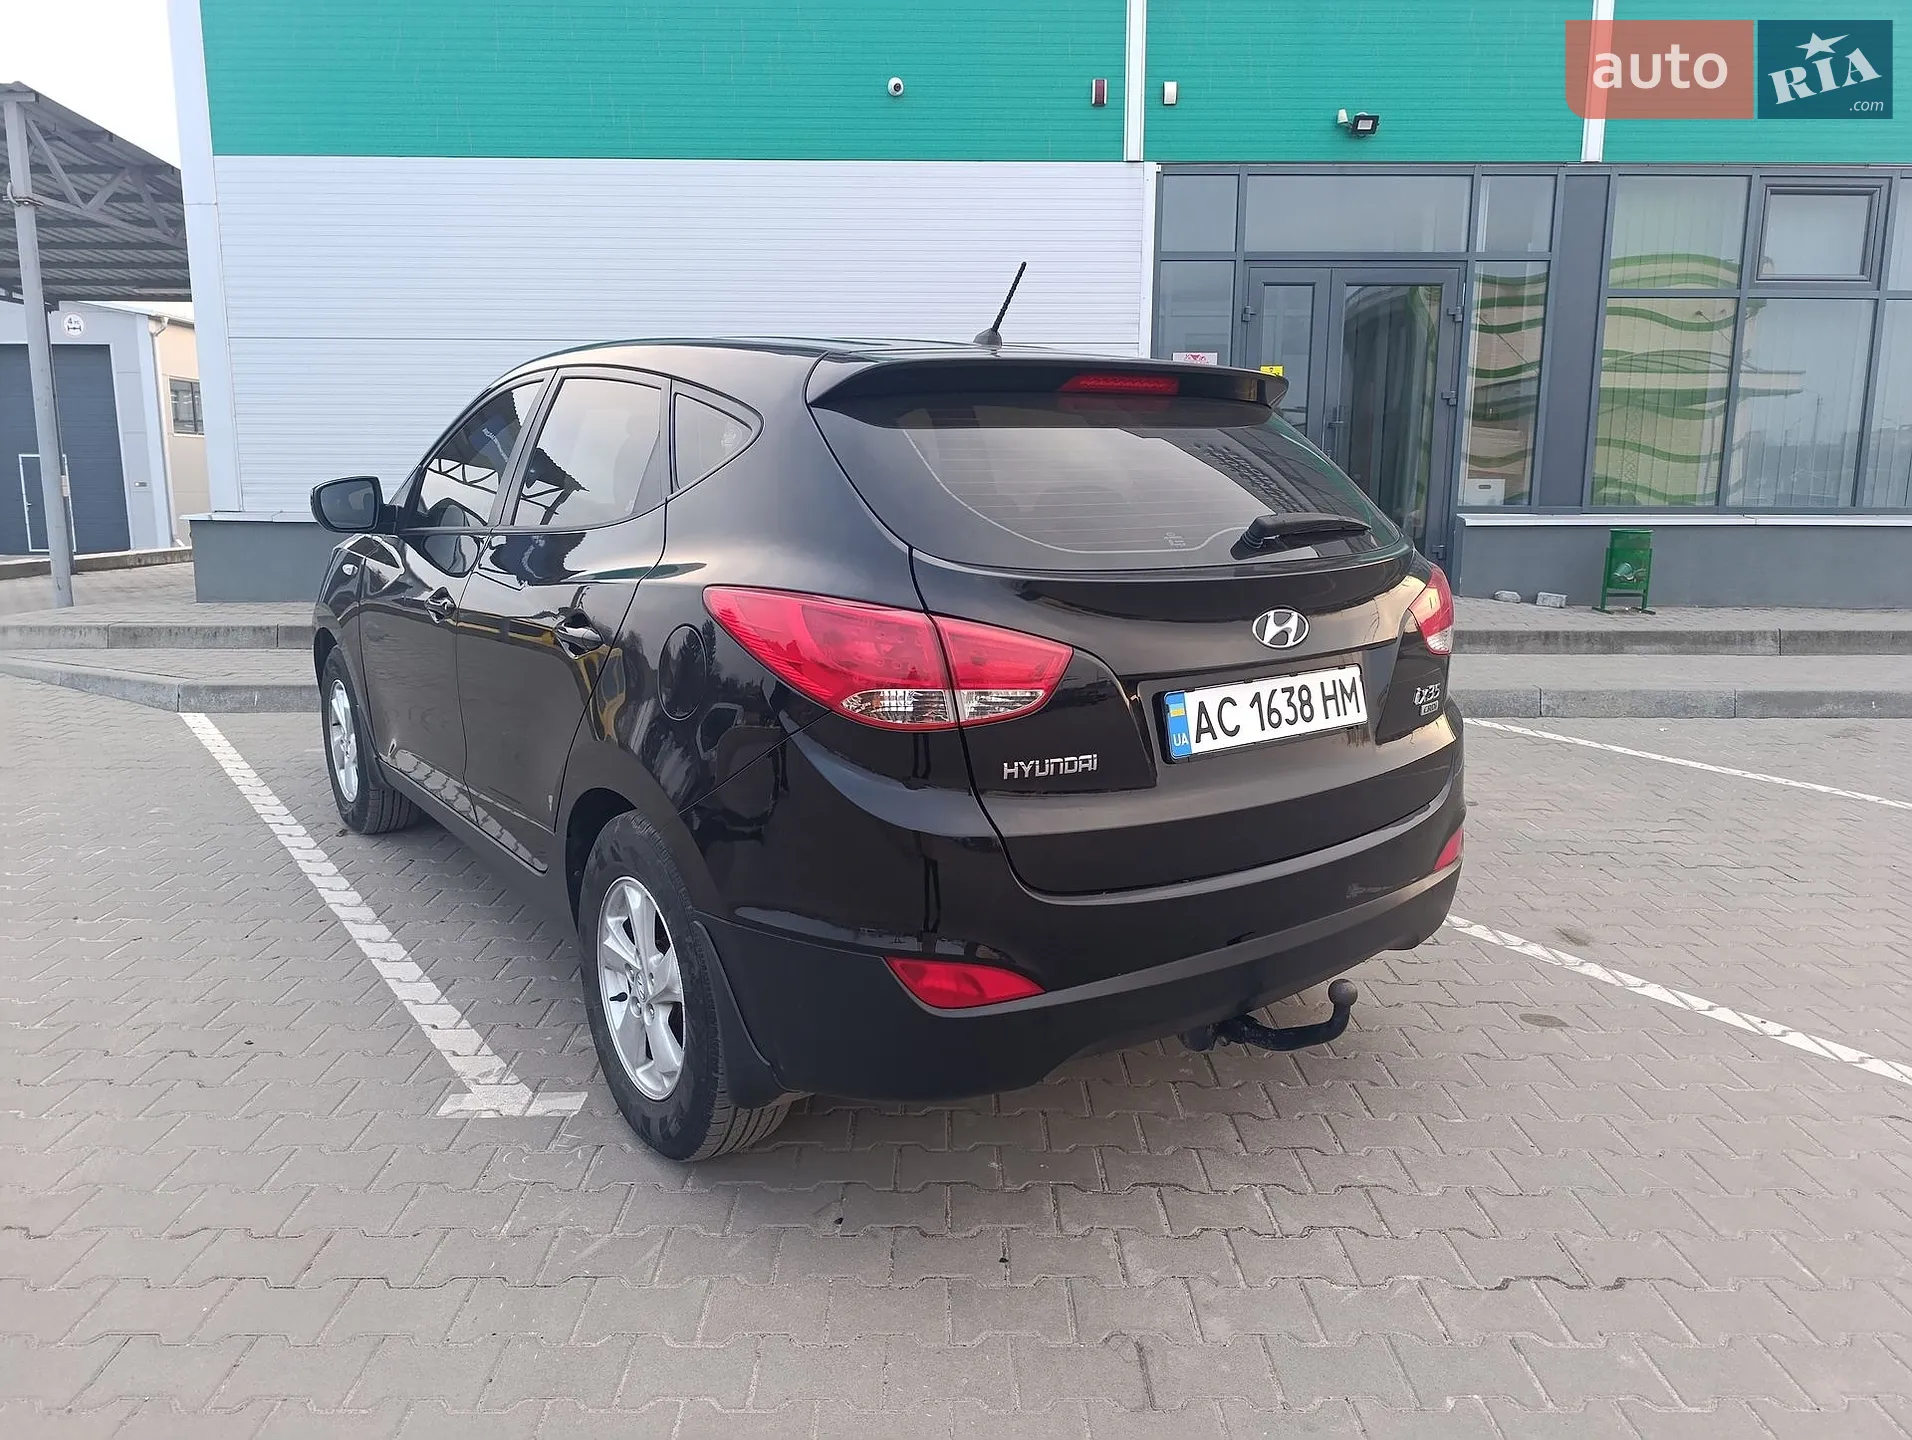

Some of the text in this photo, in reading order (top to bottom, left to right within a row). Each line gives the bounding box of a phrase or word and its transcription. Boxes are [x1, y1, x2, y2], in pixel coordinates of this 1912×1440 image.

[1195, 676, 1361, 744] AC 1638 HM
[1173, 733, 1189, 747] UA
[1003, 754, 1098, 780] HYUNDAI
